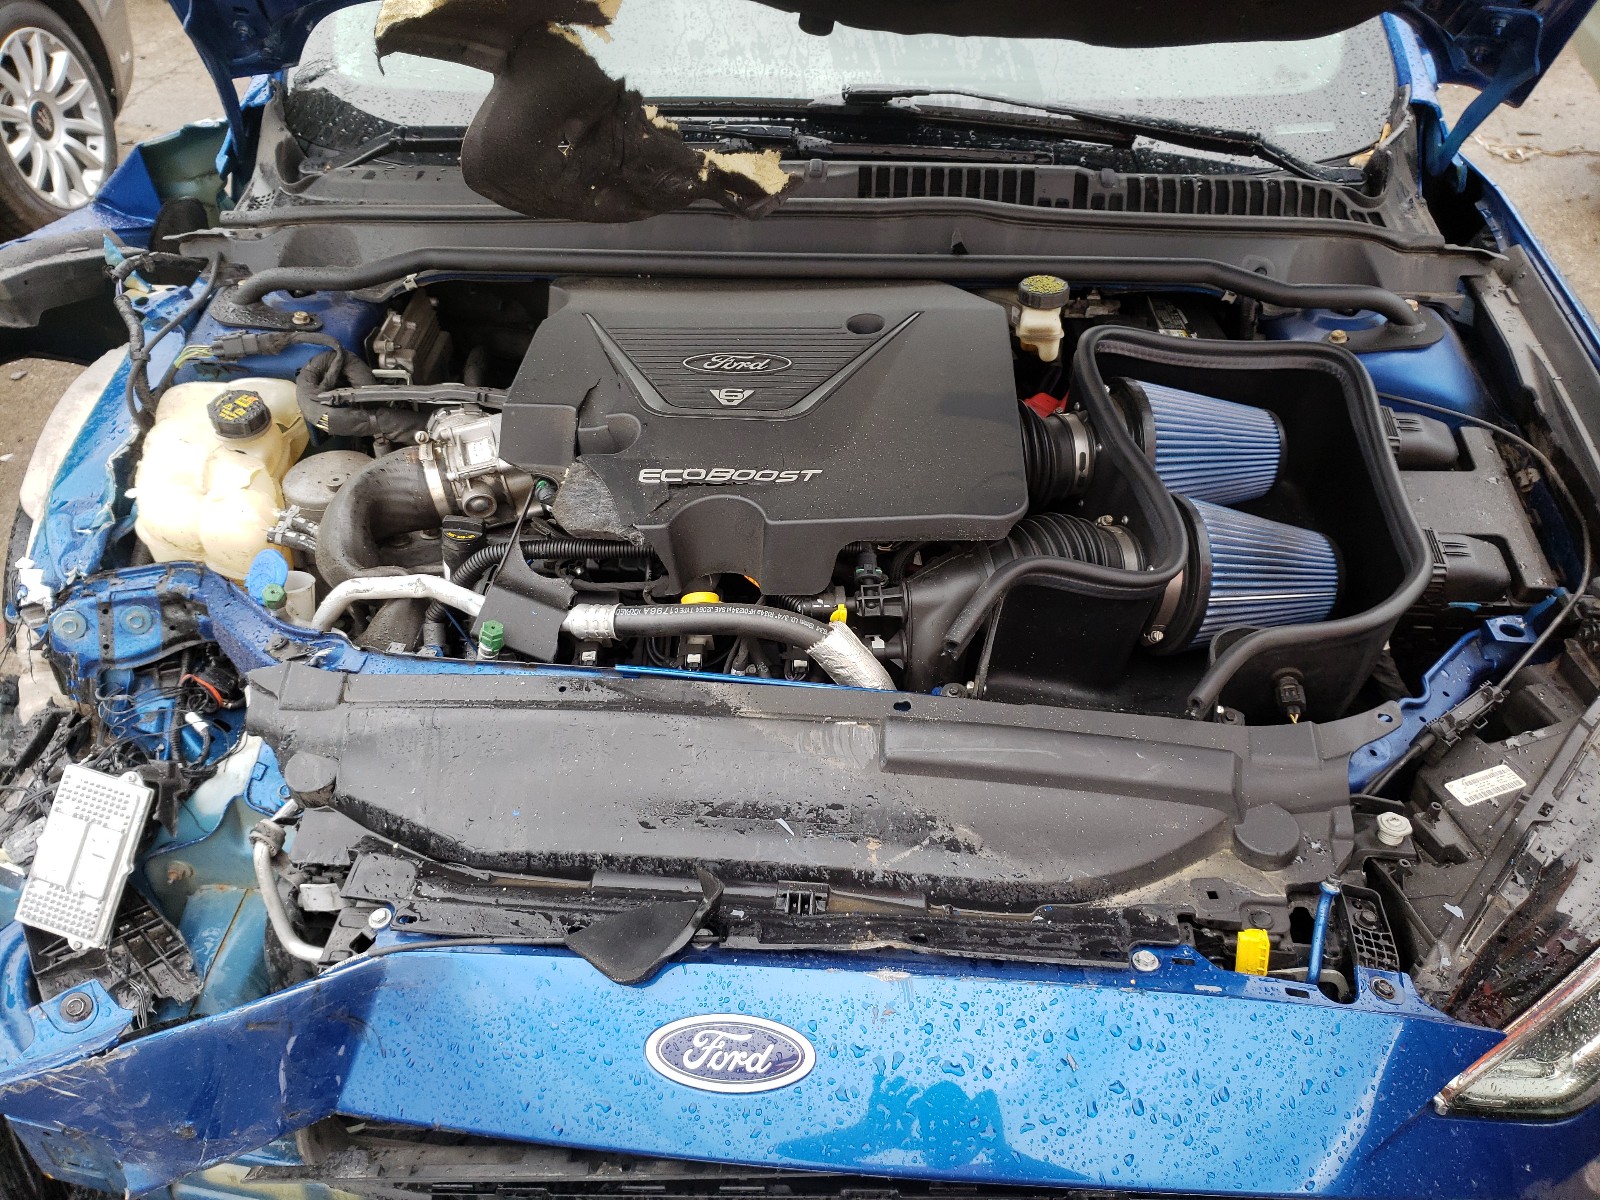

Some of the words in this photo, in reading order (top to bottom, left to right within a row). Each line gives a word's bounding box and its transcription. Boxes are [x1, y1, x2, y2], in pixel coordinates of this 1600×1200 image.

[702, 354, 771, 371] Ford
[638, 468, 823, 484] ECOBOOST
[682, 1029, 775, 1074] Ford
